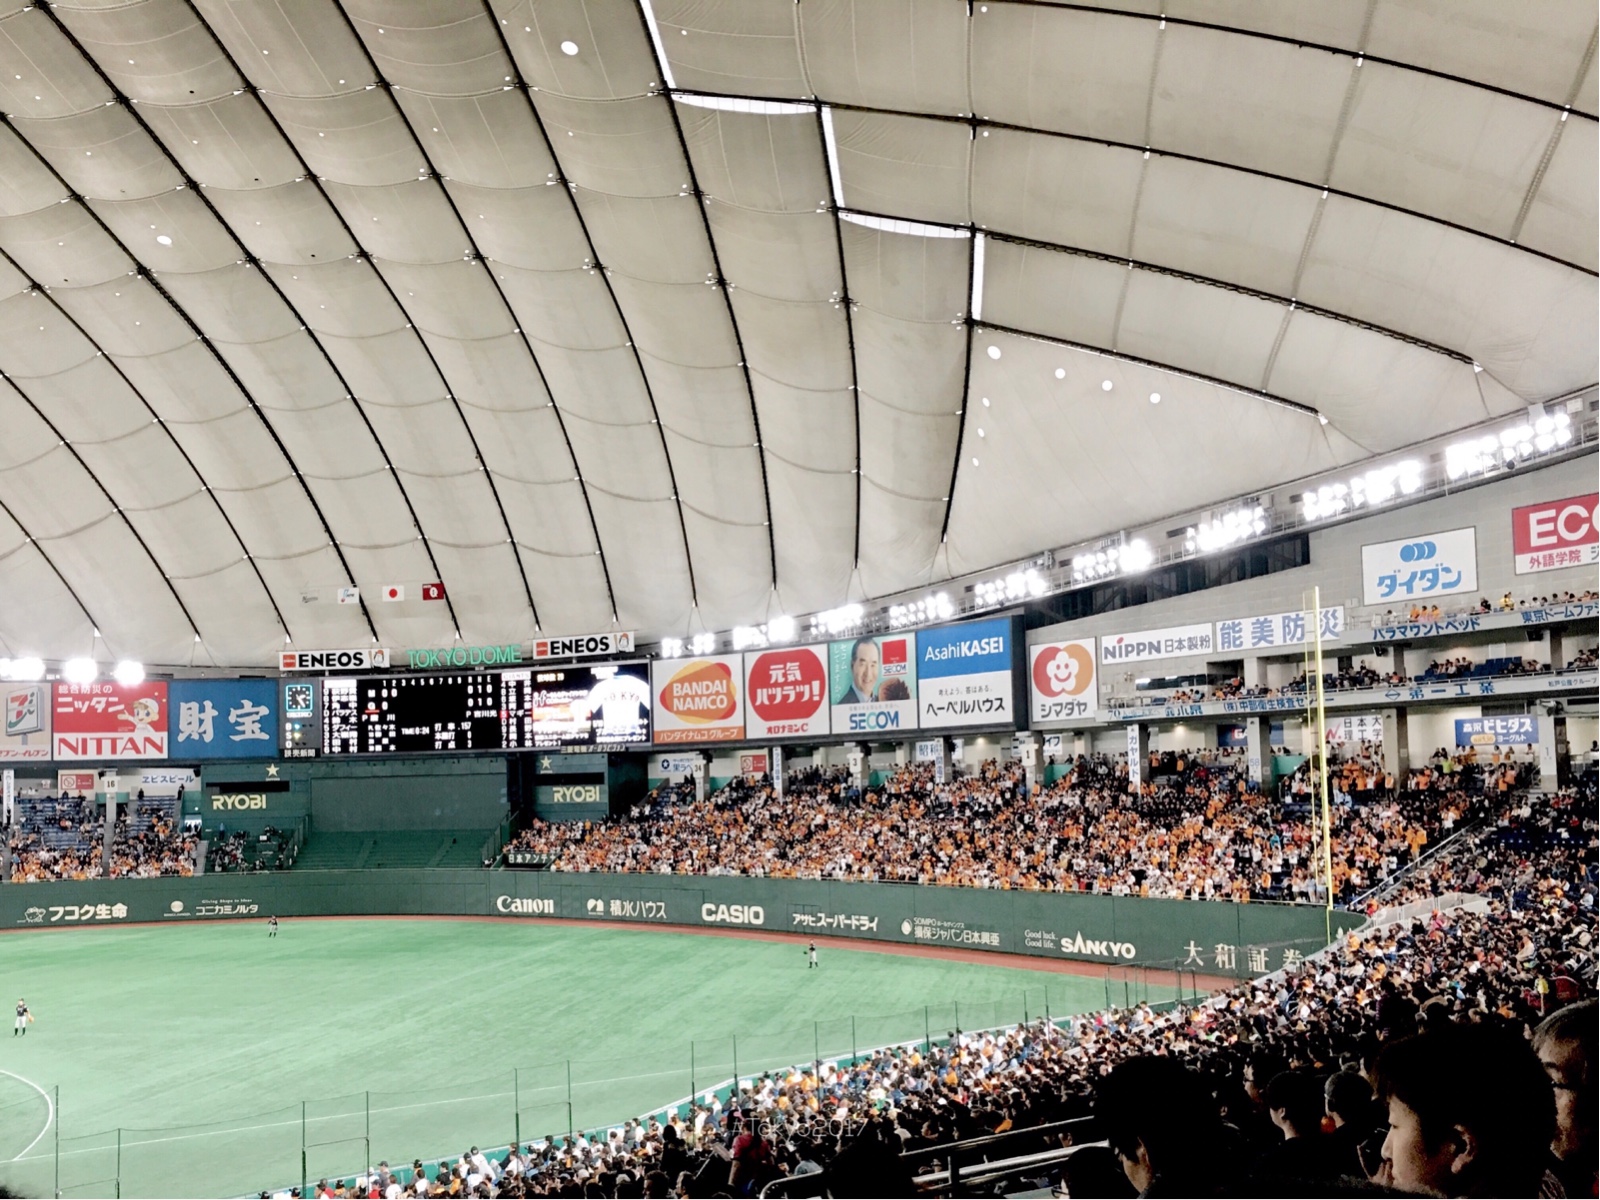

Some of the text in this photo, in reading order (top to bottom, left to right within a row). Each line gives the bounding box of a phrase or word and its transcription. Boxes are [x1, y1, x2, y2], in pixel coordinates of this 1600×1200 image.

[1529, 503, 1599, 547] EC
[1529, 549, 1581, 569] 外語学院
[1377, 563, 1461, 598] ダイダン
[1219, 608, 1340, 650] 能美防災
[1373, 616, 1481, 640] パラマウントベッド
[550, 636, 610, 655] ENEOS
[1165, 635, 1211, 653] 日本製粉
[299, 652, 364, 668] ENEOS
[407, 644, 523, 668] TOKYO DOME
[769, 662, 802, 684] 元気
[58, 684, 113, 694] 総合防災の
[673, 679, 727, 697] BANDAI
[57, 697, 125, 713] ニッタン
[673, 695, 728, 711] NAMCO
[927, 697, 1005, 717] ヘーベルハウス
[1041, 698, 1088, 718] シマダヤ
[177, 699, 270, 743] 財宝
[766, 723, 808, 735] オロナミンC
[849, 711, 899, 730] SECOM
[1344, 717, 1382, 728] 日本大
[1484, 718, 1533, 734] ビヒダス
[660, 730, 709, 741] バンダイナムコ
[709, 728, 738, 739] グループ
[58, 736, 164, 756] NITTAN
[853, 758, 857, 766] 3
[106, 780, 115, 788] 16
[211, 794, 267, 810] RYOBI
[553, 786, 600, 802] RYOBI
[49, 903, 128, 922] フコク生命
[195, 904, 258, 916] コニカミノルタ
[496, 895, 554, 913] Canon
[610, 900, 667, 919] 積水ハウス
[702, 903, 764, 924] CASIO
[913, 917, 936, 926] SOMPO
[914, 925, 1000, 945] 損保ジャパン日本興亜
[1025, 929, 1041, 939] Good
[1025, 938, 1056, 949] Good life.
[1061, 930, 1136, 959] SANKYO
